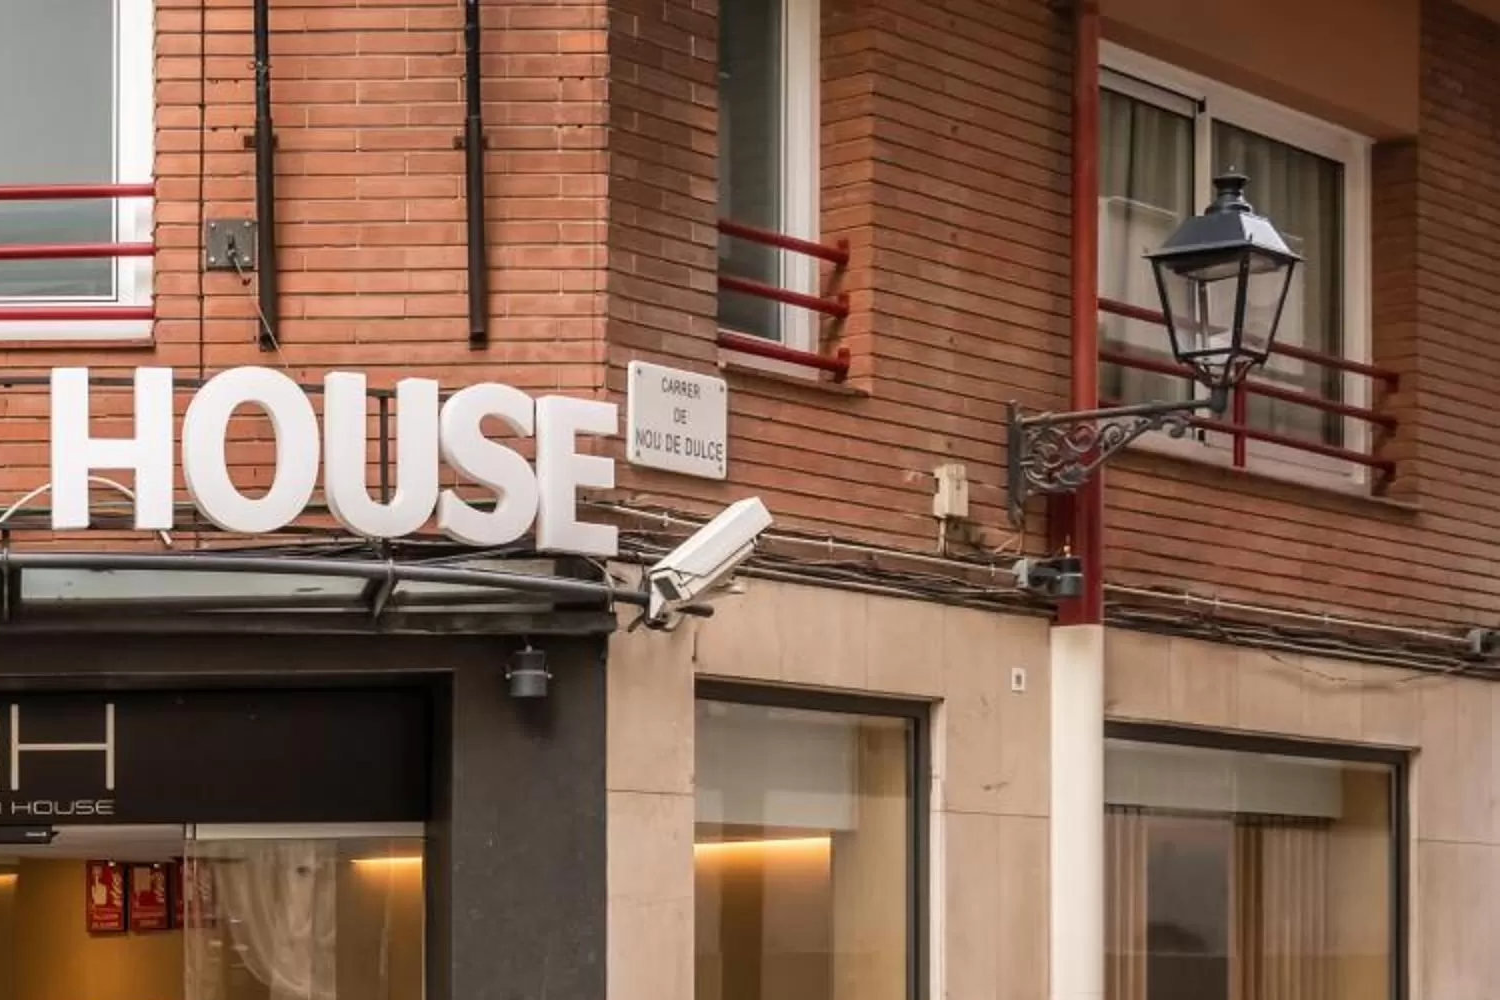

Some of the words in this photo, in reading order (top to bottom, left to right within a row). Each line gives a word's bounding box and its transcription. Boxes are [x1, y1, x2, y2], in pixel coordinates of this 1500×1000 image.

[661, 376, 701, 399] CARRER
[673, 407, 688, 425] DE
[635, 427, 661, 451] NOU
[665, 433, 681, 455] DE
[685, 437, 724, 463] DULCE
[50, 365, 619, 556] HOUSE
[11, 799, 115, 816] HOUSE
